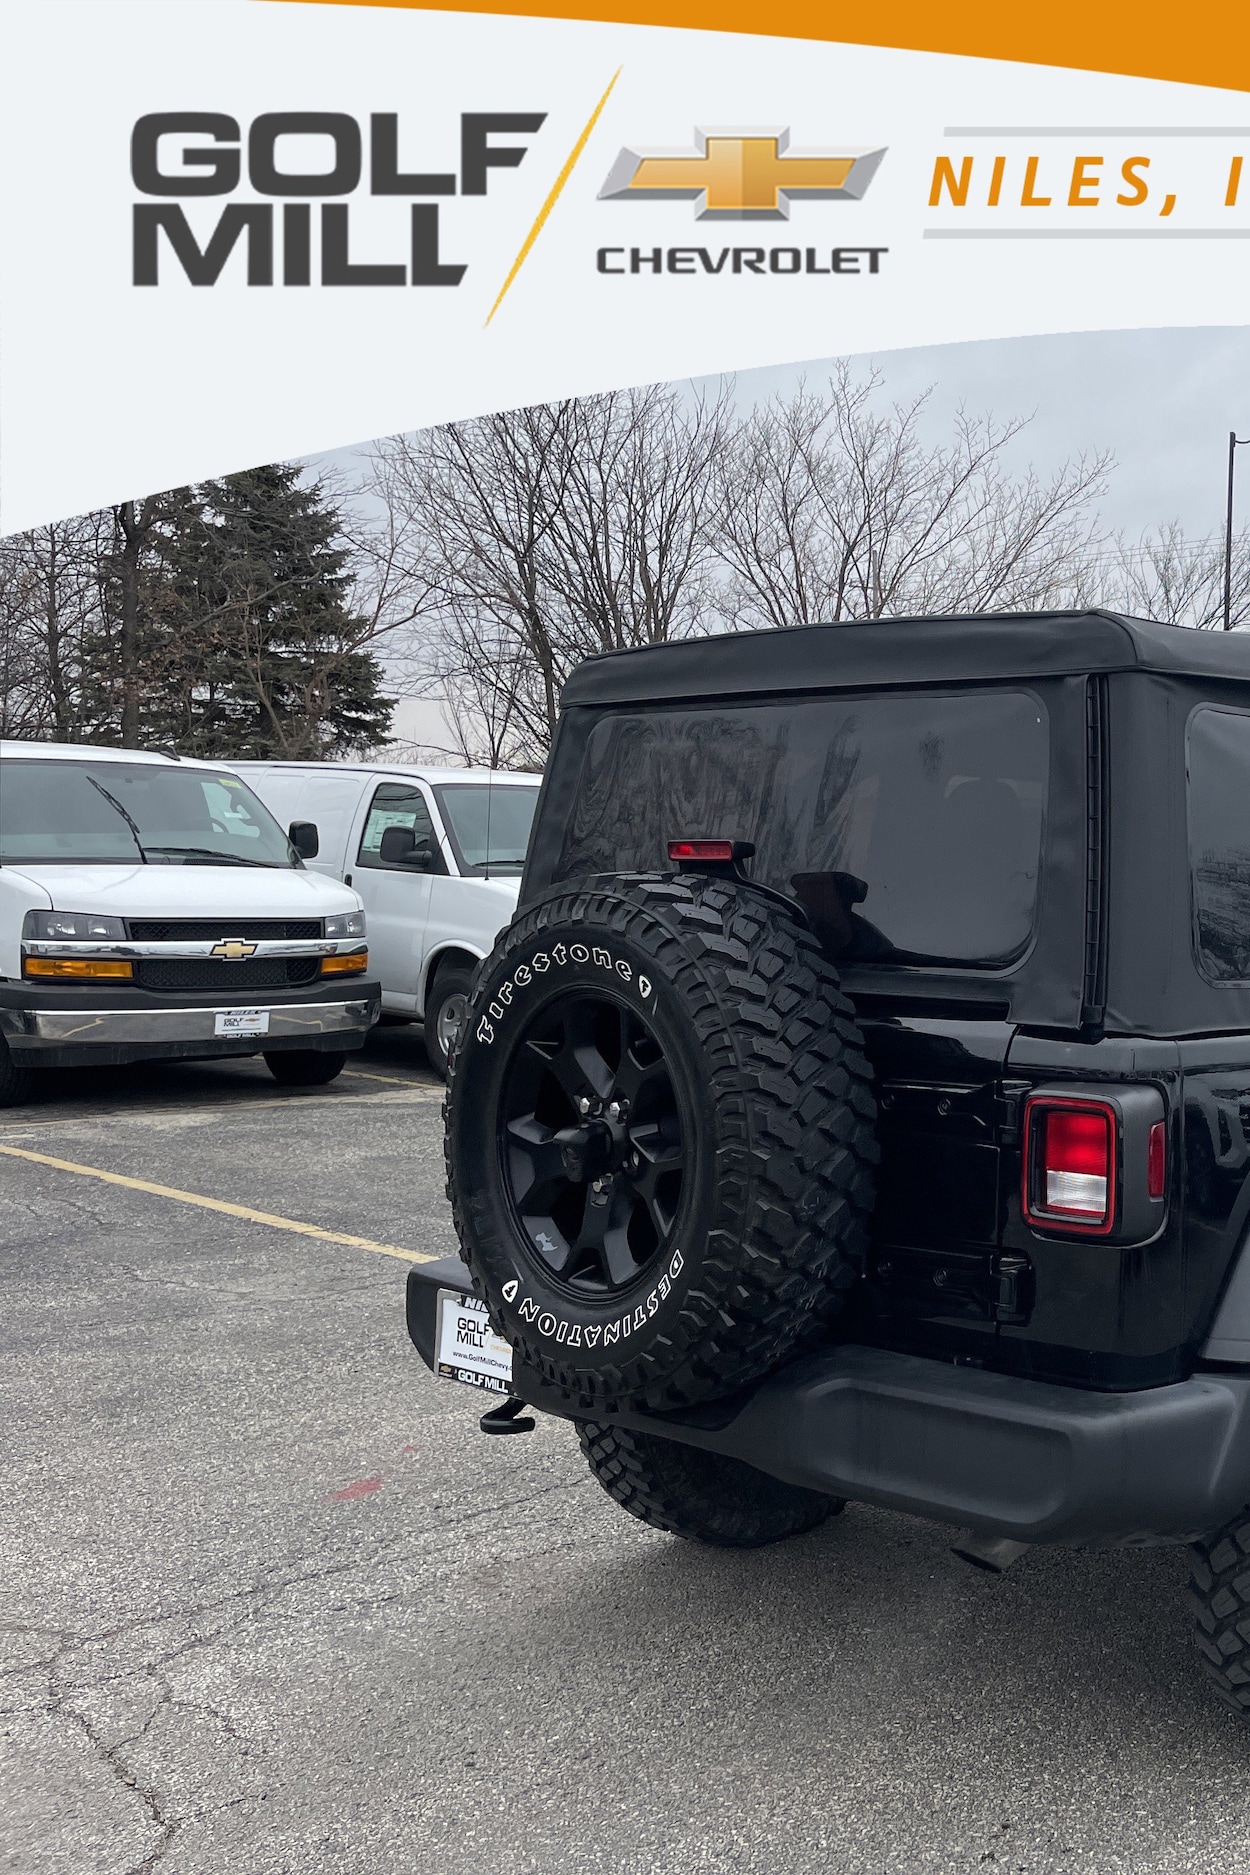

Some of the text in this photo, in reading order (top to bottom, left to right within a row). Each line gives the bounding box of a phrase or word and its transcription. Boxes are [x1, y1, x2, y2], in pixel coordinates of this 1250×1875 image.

[518, 1249, 684, 1348] DESTINATION
[458, 1317, 490, 1335] GOLF
[457, 1330, 485, 1348] MILL
[458, 1370, 509, 1393] GOLF MILL
